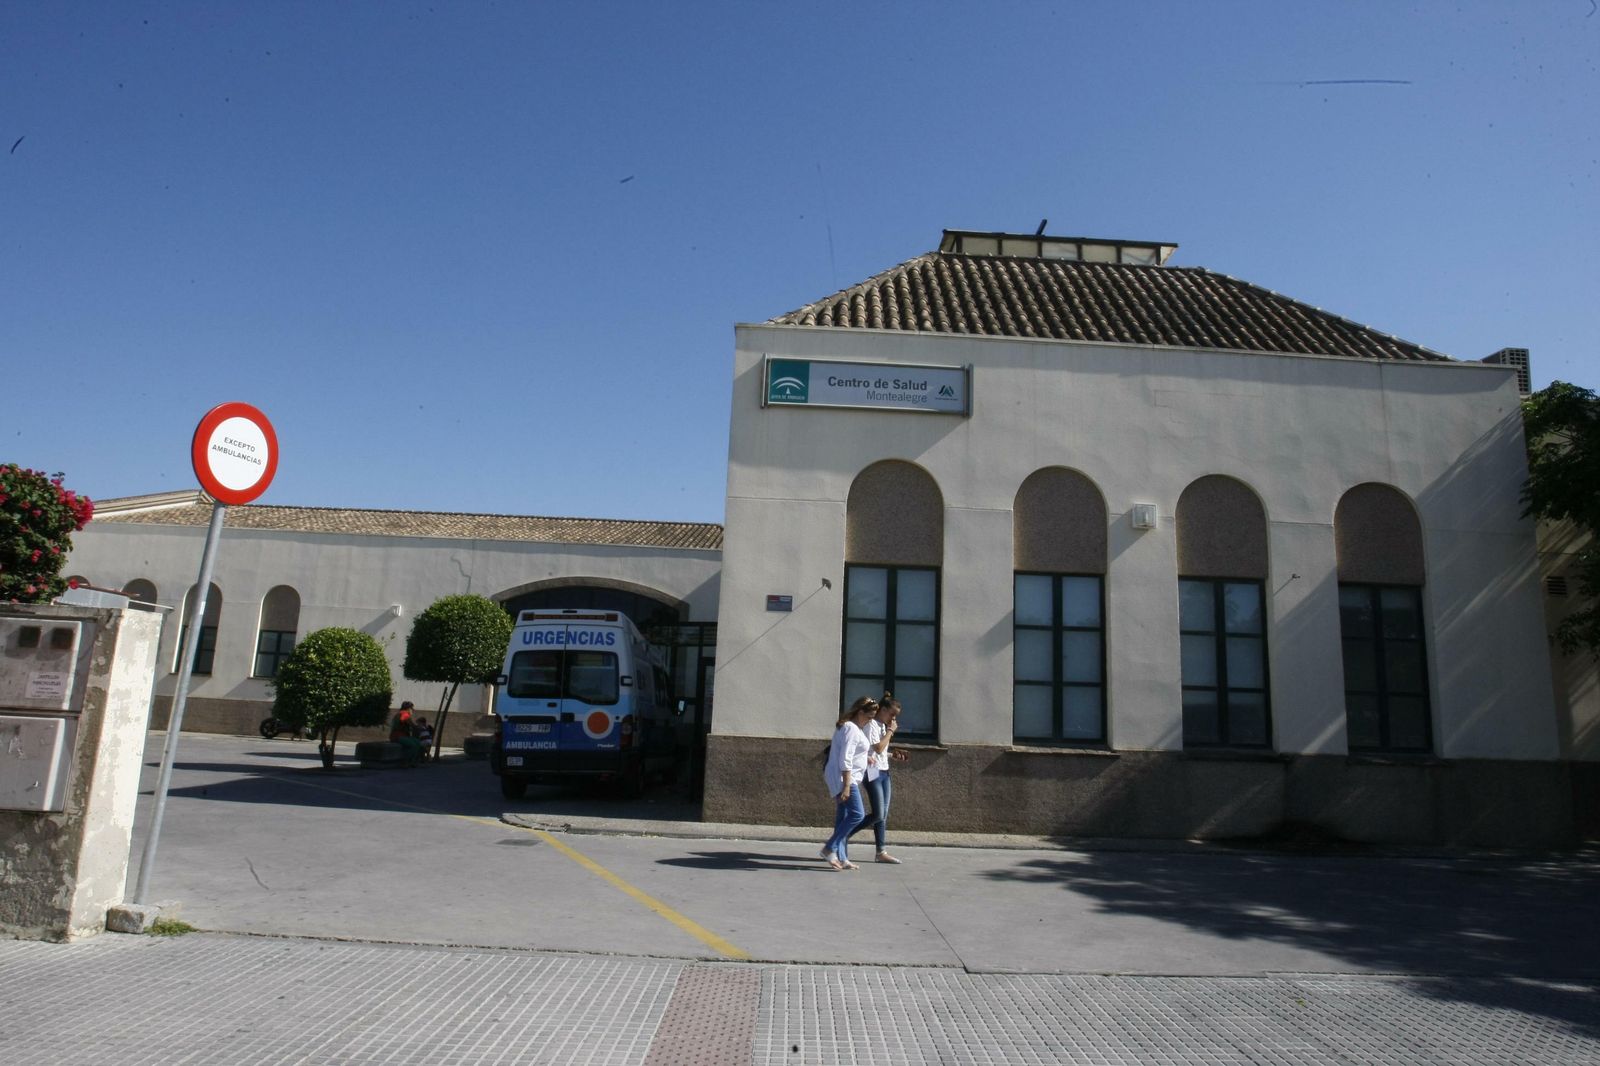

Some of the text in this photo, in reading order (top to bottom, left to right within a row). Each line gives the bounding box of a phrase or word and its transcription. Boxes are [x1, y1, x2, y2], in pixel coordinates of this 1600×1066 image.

[828, 376, 928, 391] Centro de Salud
[866, 390, 928, 404] Montealegre
[223, 436, 256, 452] EXCEPTO
[212, 444, 262, 465] AMBULANCIAS
[522, 630, 615, 646] URGENCIAS
[505, 741, 557, 750] AMBULANCIA
